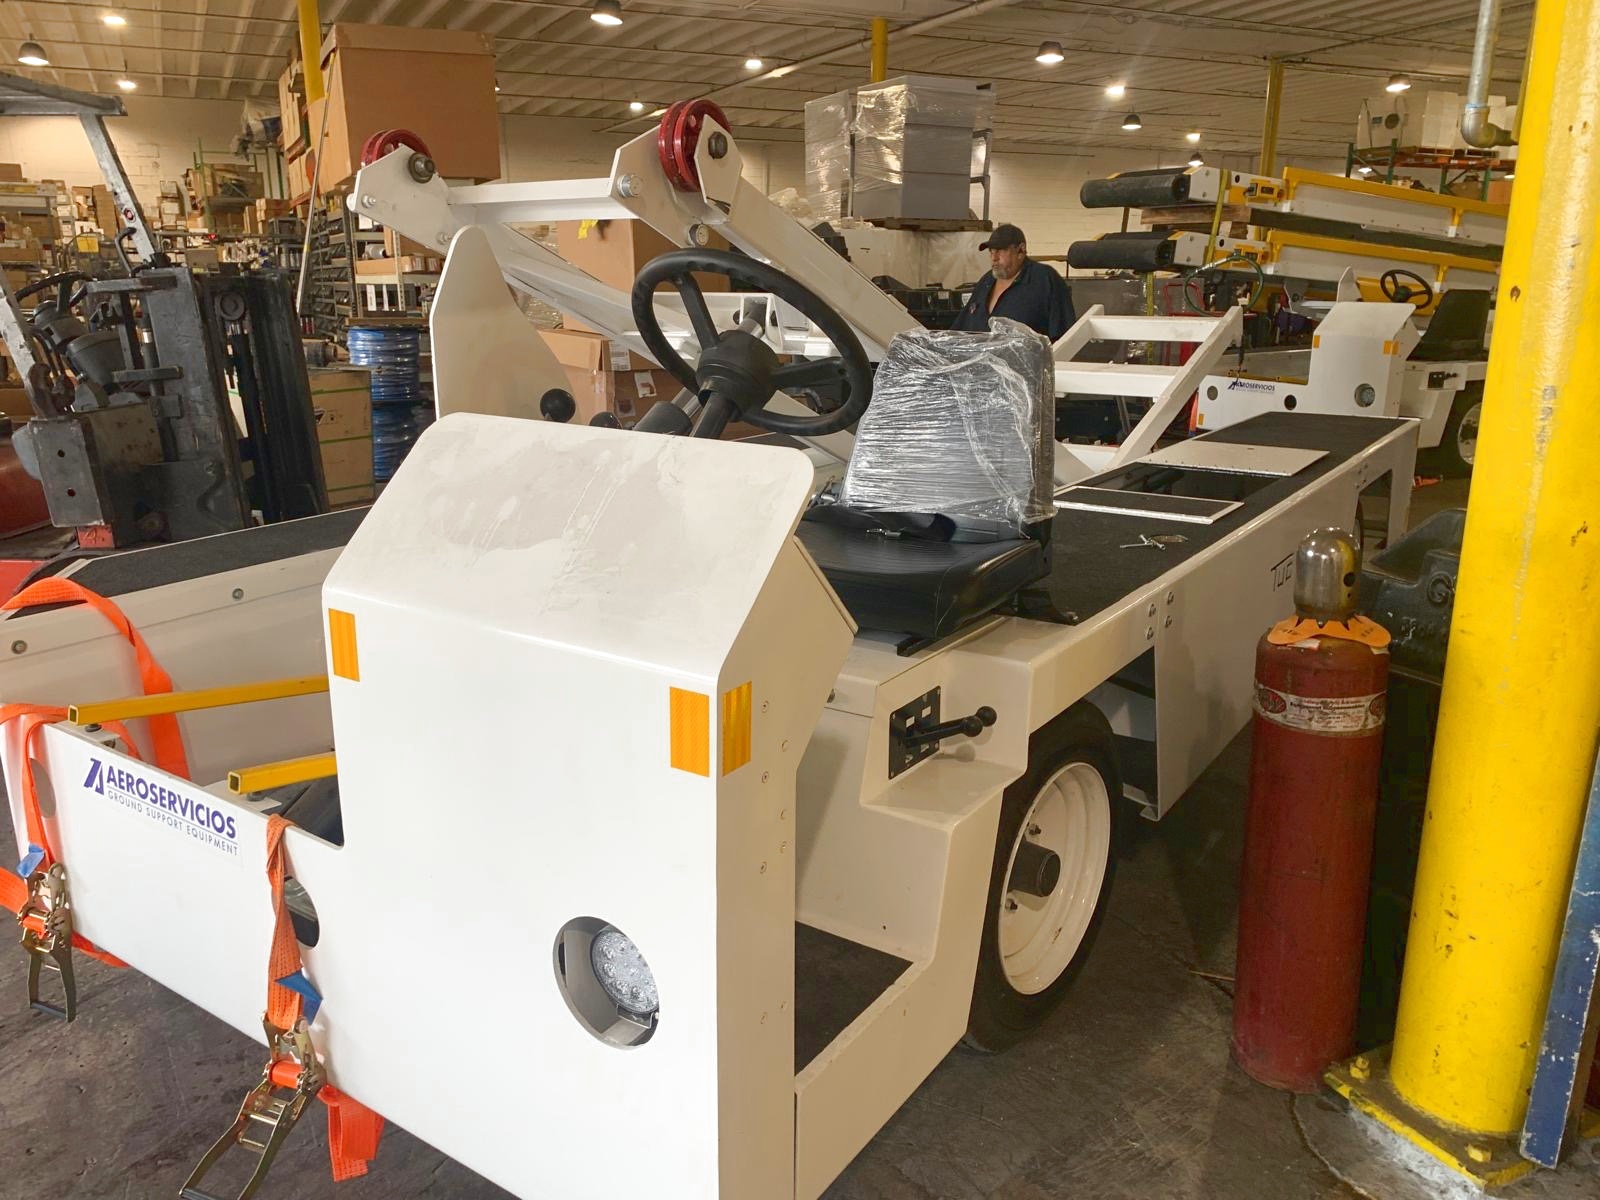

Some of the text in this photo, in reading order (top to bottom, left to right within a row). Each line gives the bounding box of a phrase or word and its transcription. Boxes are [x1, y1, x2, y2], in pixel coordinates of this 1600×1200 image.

[107, 765, 236, 839] AEROSERVICIOS
[108, 790, 238, 856] GROUND SUPPORT EQUIPMENT
